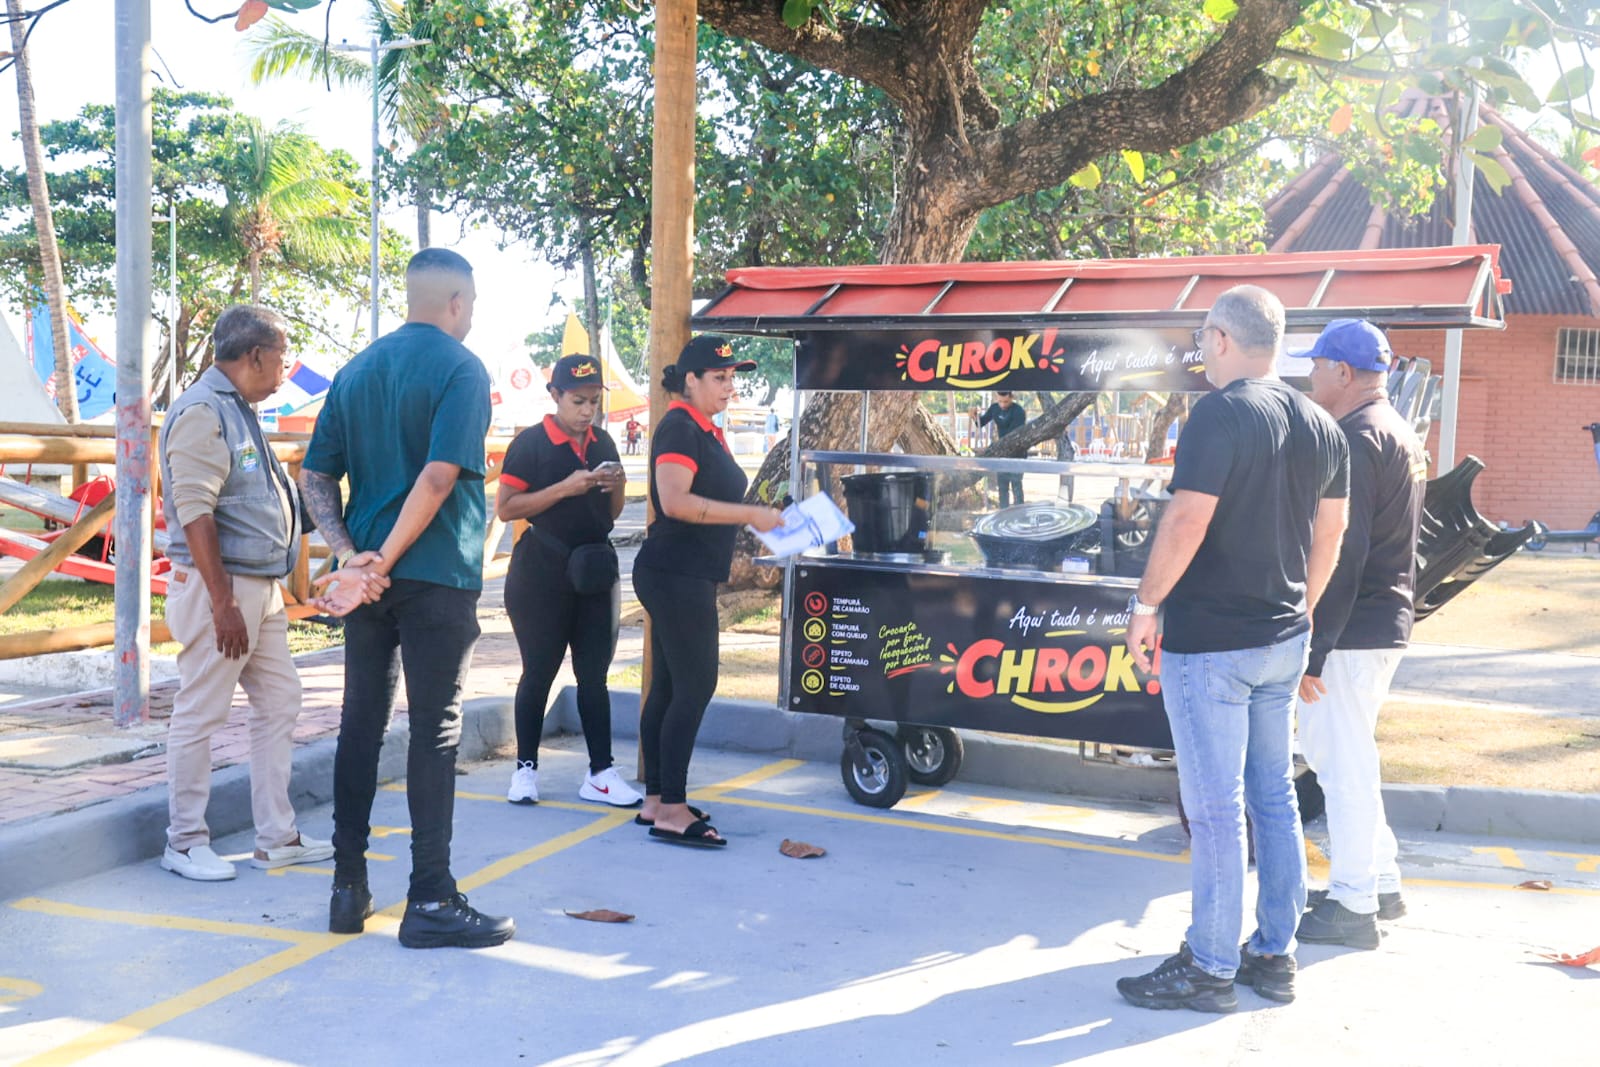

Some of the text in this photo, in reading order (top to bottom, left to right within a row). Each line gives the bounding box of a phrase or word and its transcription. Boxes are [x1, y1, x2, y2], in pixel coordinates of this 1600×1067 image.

[906, 327, 1059, 383] CHROK!
[1080, 345, 1204, 383] Aqui tudo é ma
[1009, 605, 1046, 637] Aqui
[1050, 606, 1080, 627] tudo
[1086, 608, 1097, 626] é
[846, 631, 868, 640] QUEIJO
[879, 621, 917, 639] Crocante
[885, 638, 900, 651] por
[831, 649, 853, 658] ESPETO
[884, 661, 900, 675] por
[955, 634, 1163, 698] CHROK!
[830, 675, 852, 683] ESPETO
[838, 683, 860, 691] QUEIJO
